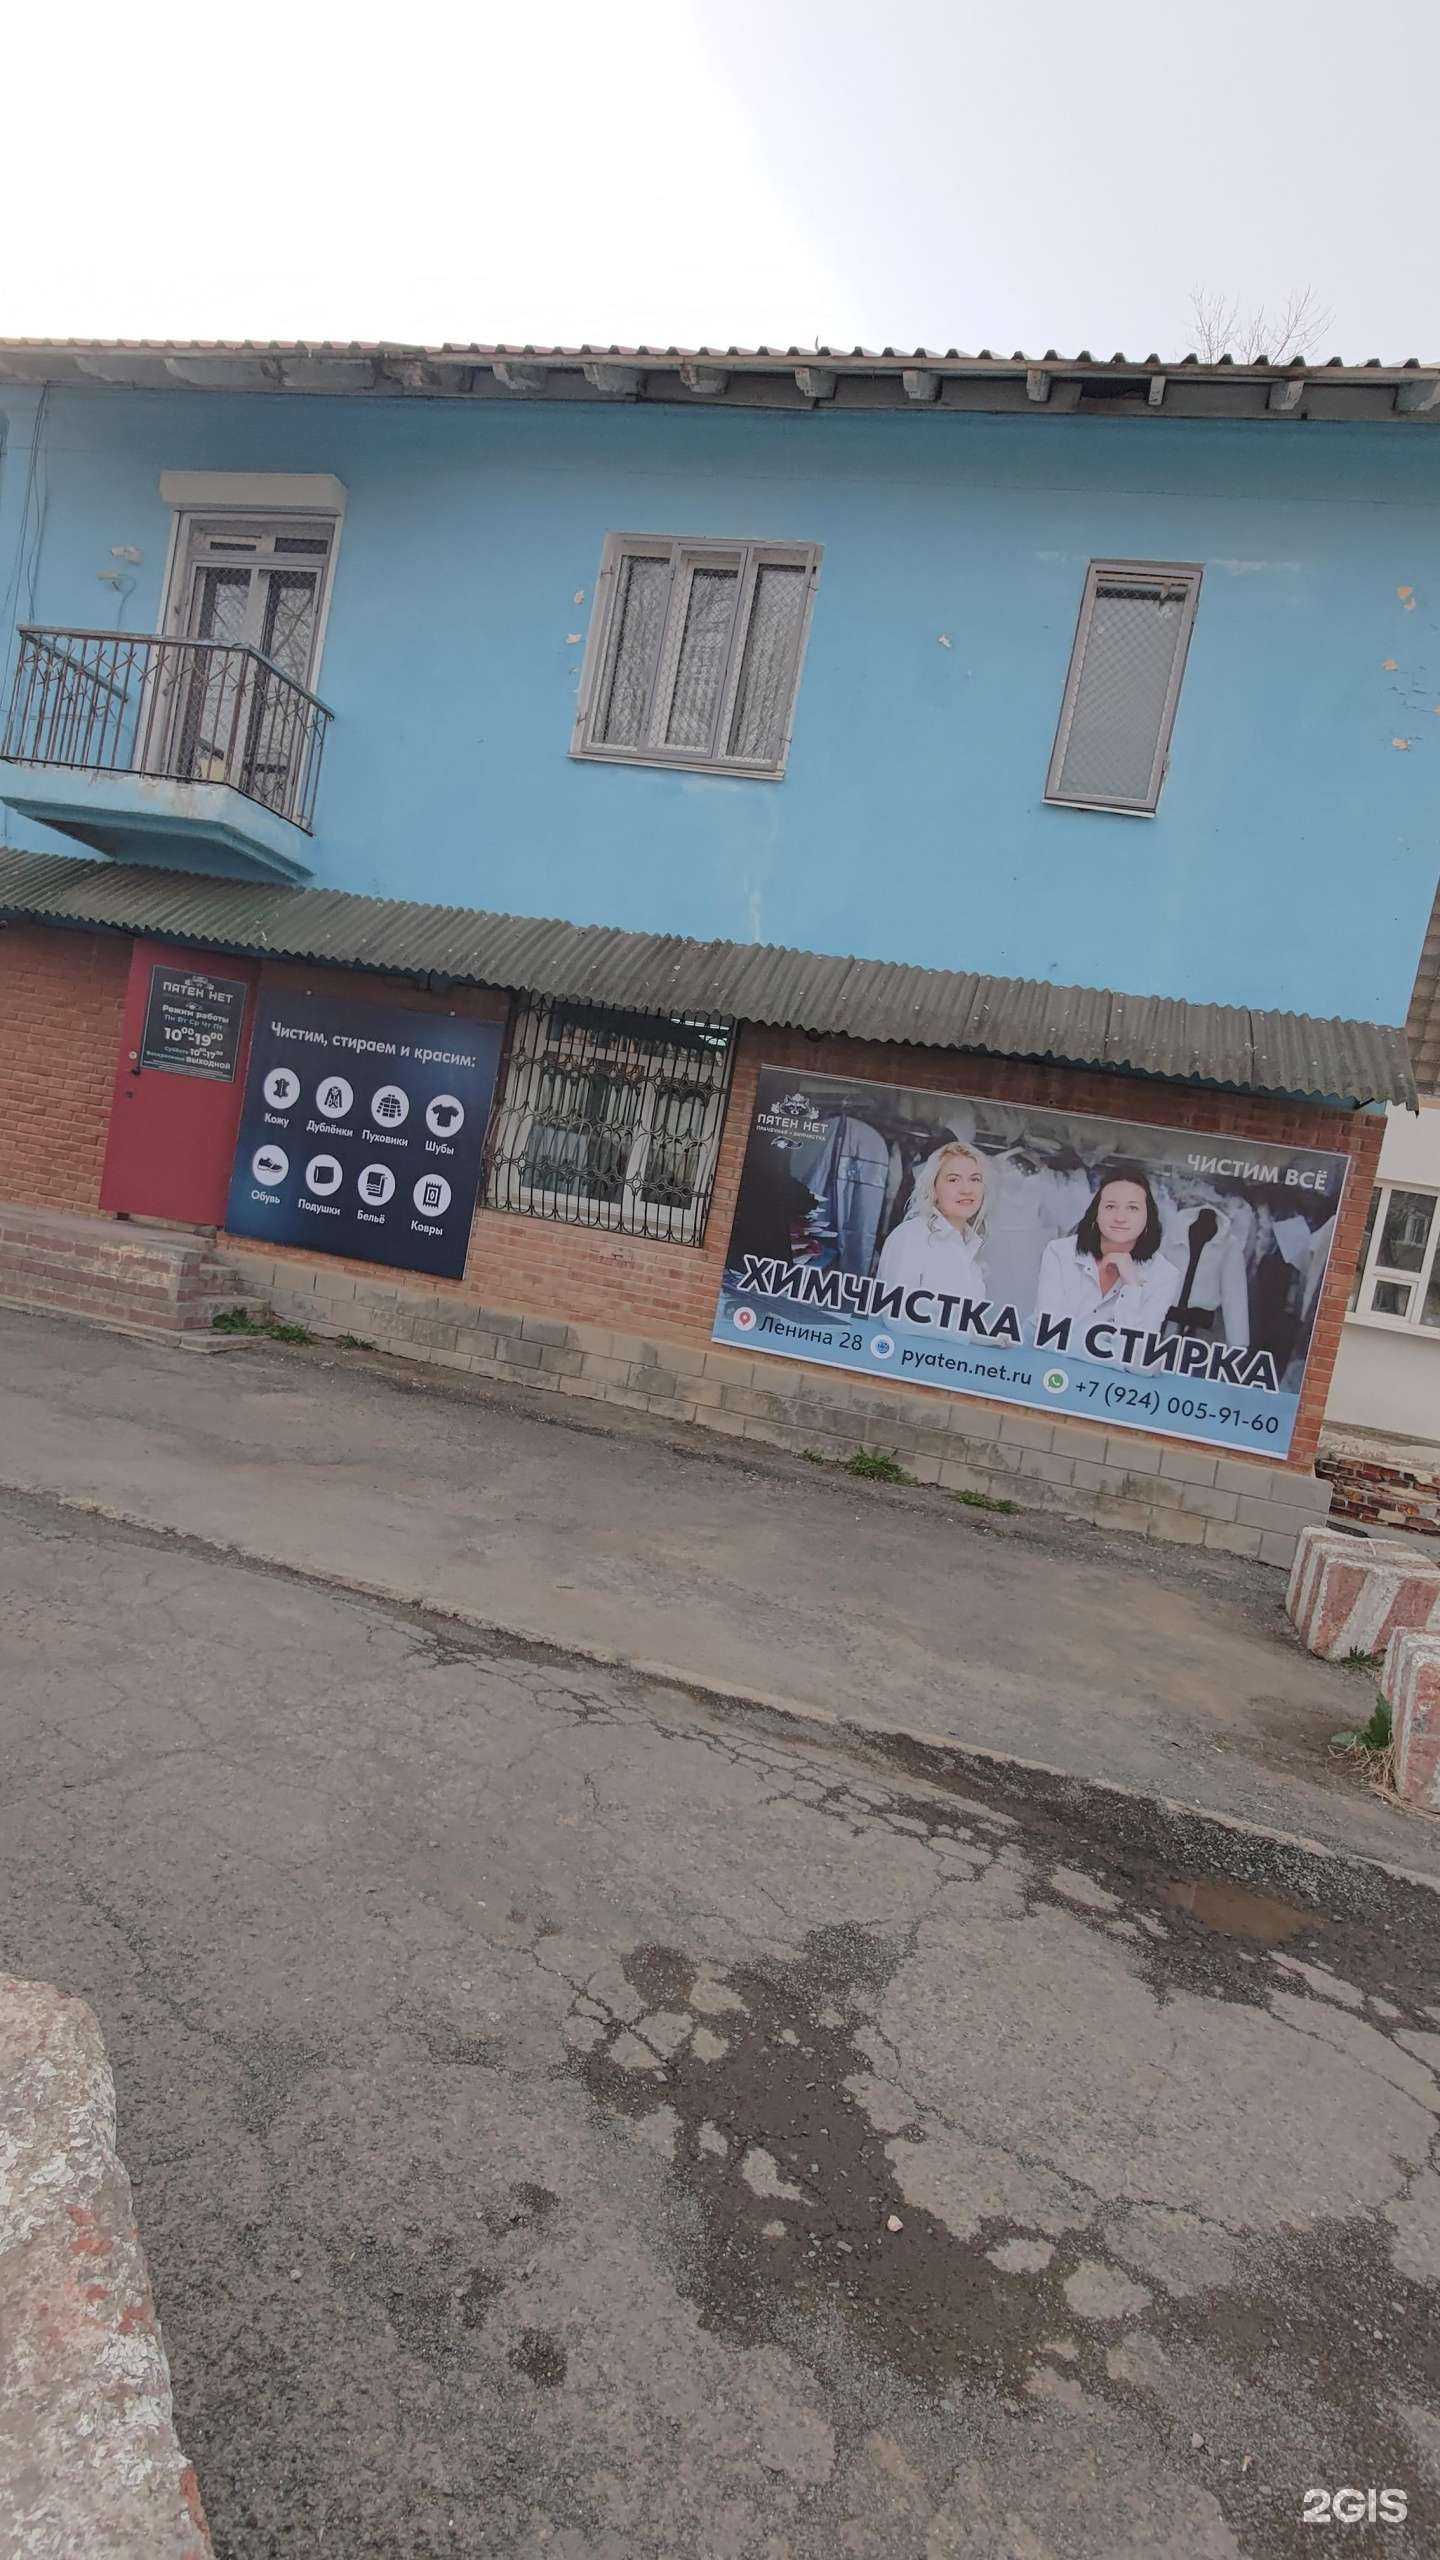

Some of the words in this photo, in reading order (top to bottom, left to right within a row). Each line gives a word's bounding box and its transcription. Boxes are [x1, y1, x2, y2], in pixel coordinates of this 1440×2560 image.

[163, 981, 204, 998] ПЯТЕН
[208, 991, 234, 1004] НЕТ
[196, 1012, 229, 1023] работы
[271, 1020, 329, 1047] Чистим,
[332, 1033, 397, 1055] стираем
[400, 1045, 411, 1057] и
[414, 1046, 477, 1068] красим:
[263, 1112, 291, 1129] Кожу
[305, 1119, 354, 1138] Дублёнки
[361, 1129, 409, 1147] Пуховики
[424, 1140, 455, 1156] Шубы
[757, 1113, 799, 1129] ПЯТЕН
[803, 1121, 829, 1134] НЕТ
[1186, 1153, 1279, 1184] ЧИСТИМ
[1283, 1169, 1329, 1192] ВСЁ
[250, 1189, 281, 1205] Обувь
[297, 1198, 341, 1216] Подушки
[356, 1209, 386, 1225] Бельё
[410, 1220, 443, 1237] Ковры
[737, 1254, 1023, 1345] ХИМЧИСТКА
[1034, 1312, 1073, 1354] И
[1083, 1321, 1280, 1394] СТИРКА
[757, 1315, 834, 1347] Ленина
[838, 1331, 863, 1351] 28
[901, 1347, 1032, 1386] pyaten.net.ru
[1075, 1380, 1101, 1398] +7
[1104, 1382, 1160, 1416] (924)
[1166, 1396, 1280, 1434] 005-91-60
